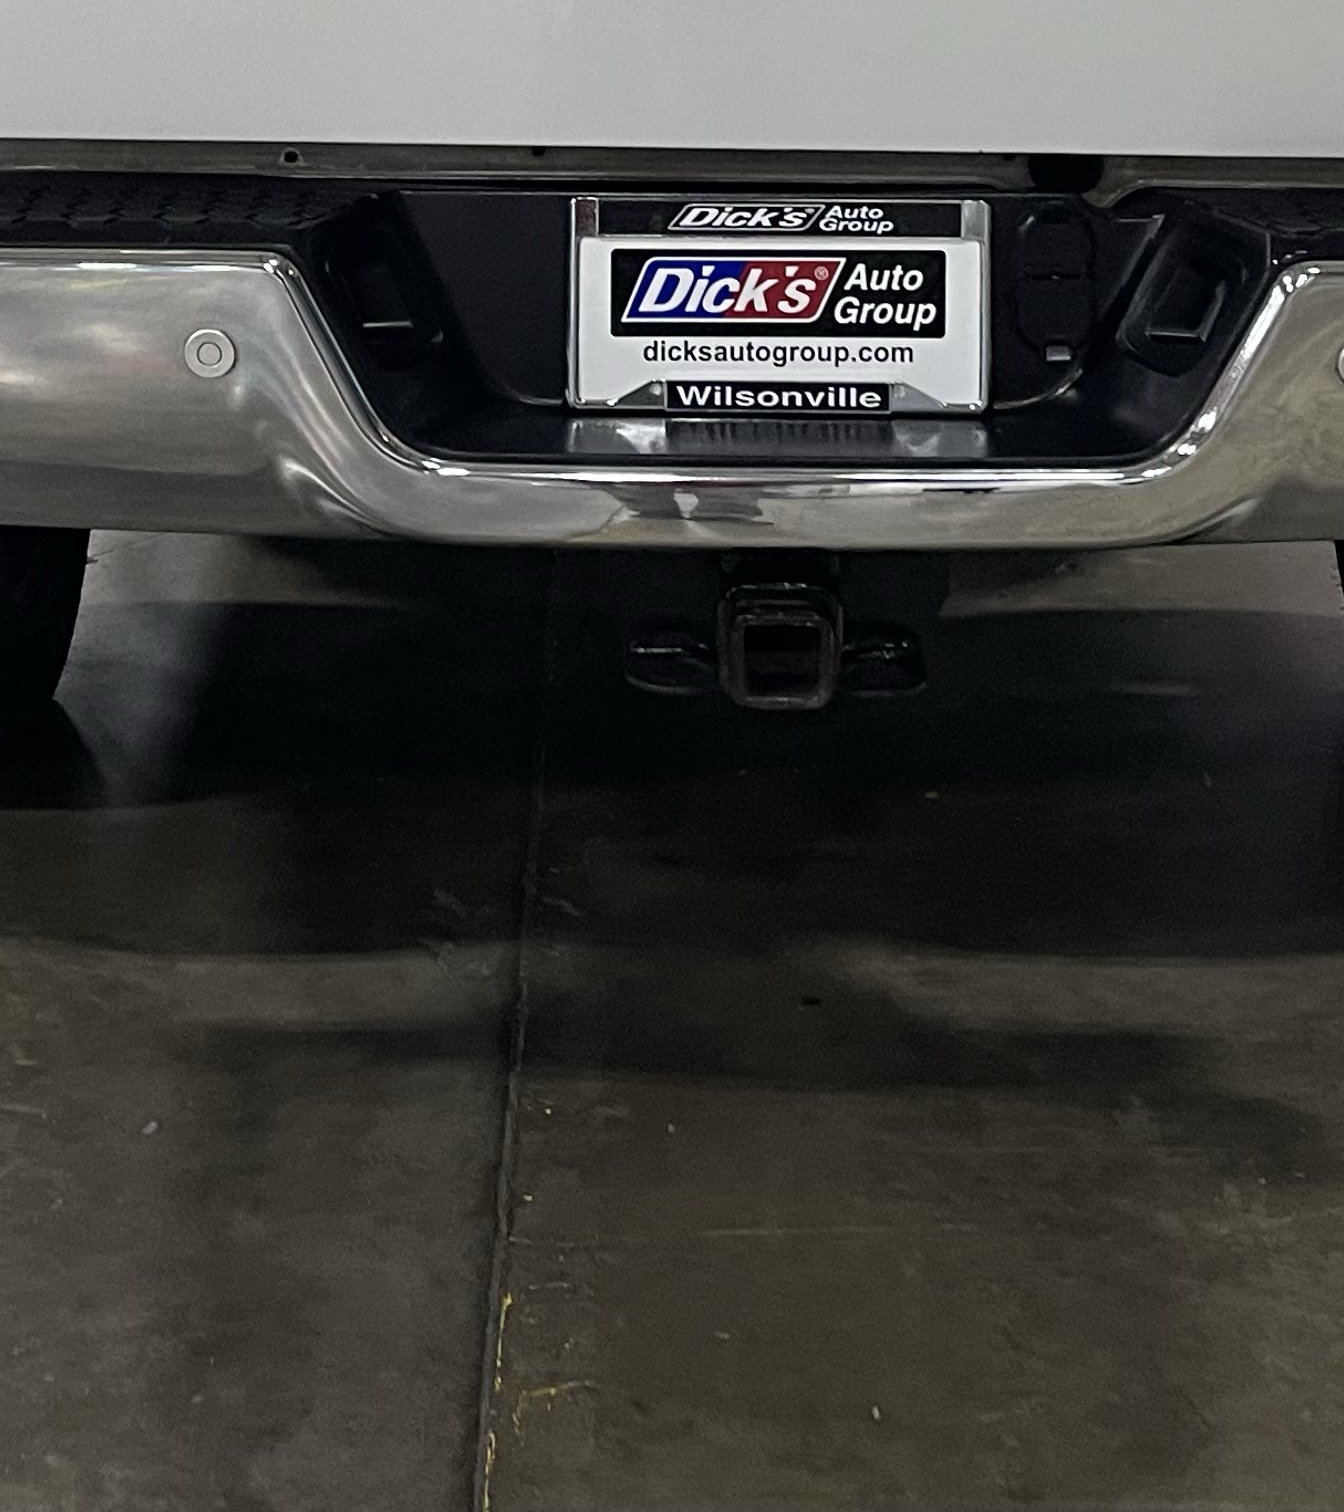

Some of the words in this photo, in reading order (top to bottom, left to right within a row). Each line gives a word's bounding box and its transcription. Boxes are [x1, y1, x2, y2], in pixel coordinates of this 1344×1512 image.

[678, 205, 809, 229] Dick's
[828, 205, 883, 219] Auto
[819, 219, 894, 234] Group
[638, 265, 816, 313] Dick's
[844, 263, 924, 291] Auto
[834, 297, 937, 331] Group
[642, 341, 914, 367] dicksautogroup.com
[676, 385, 882, 408] Wilsonville
